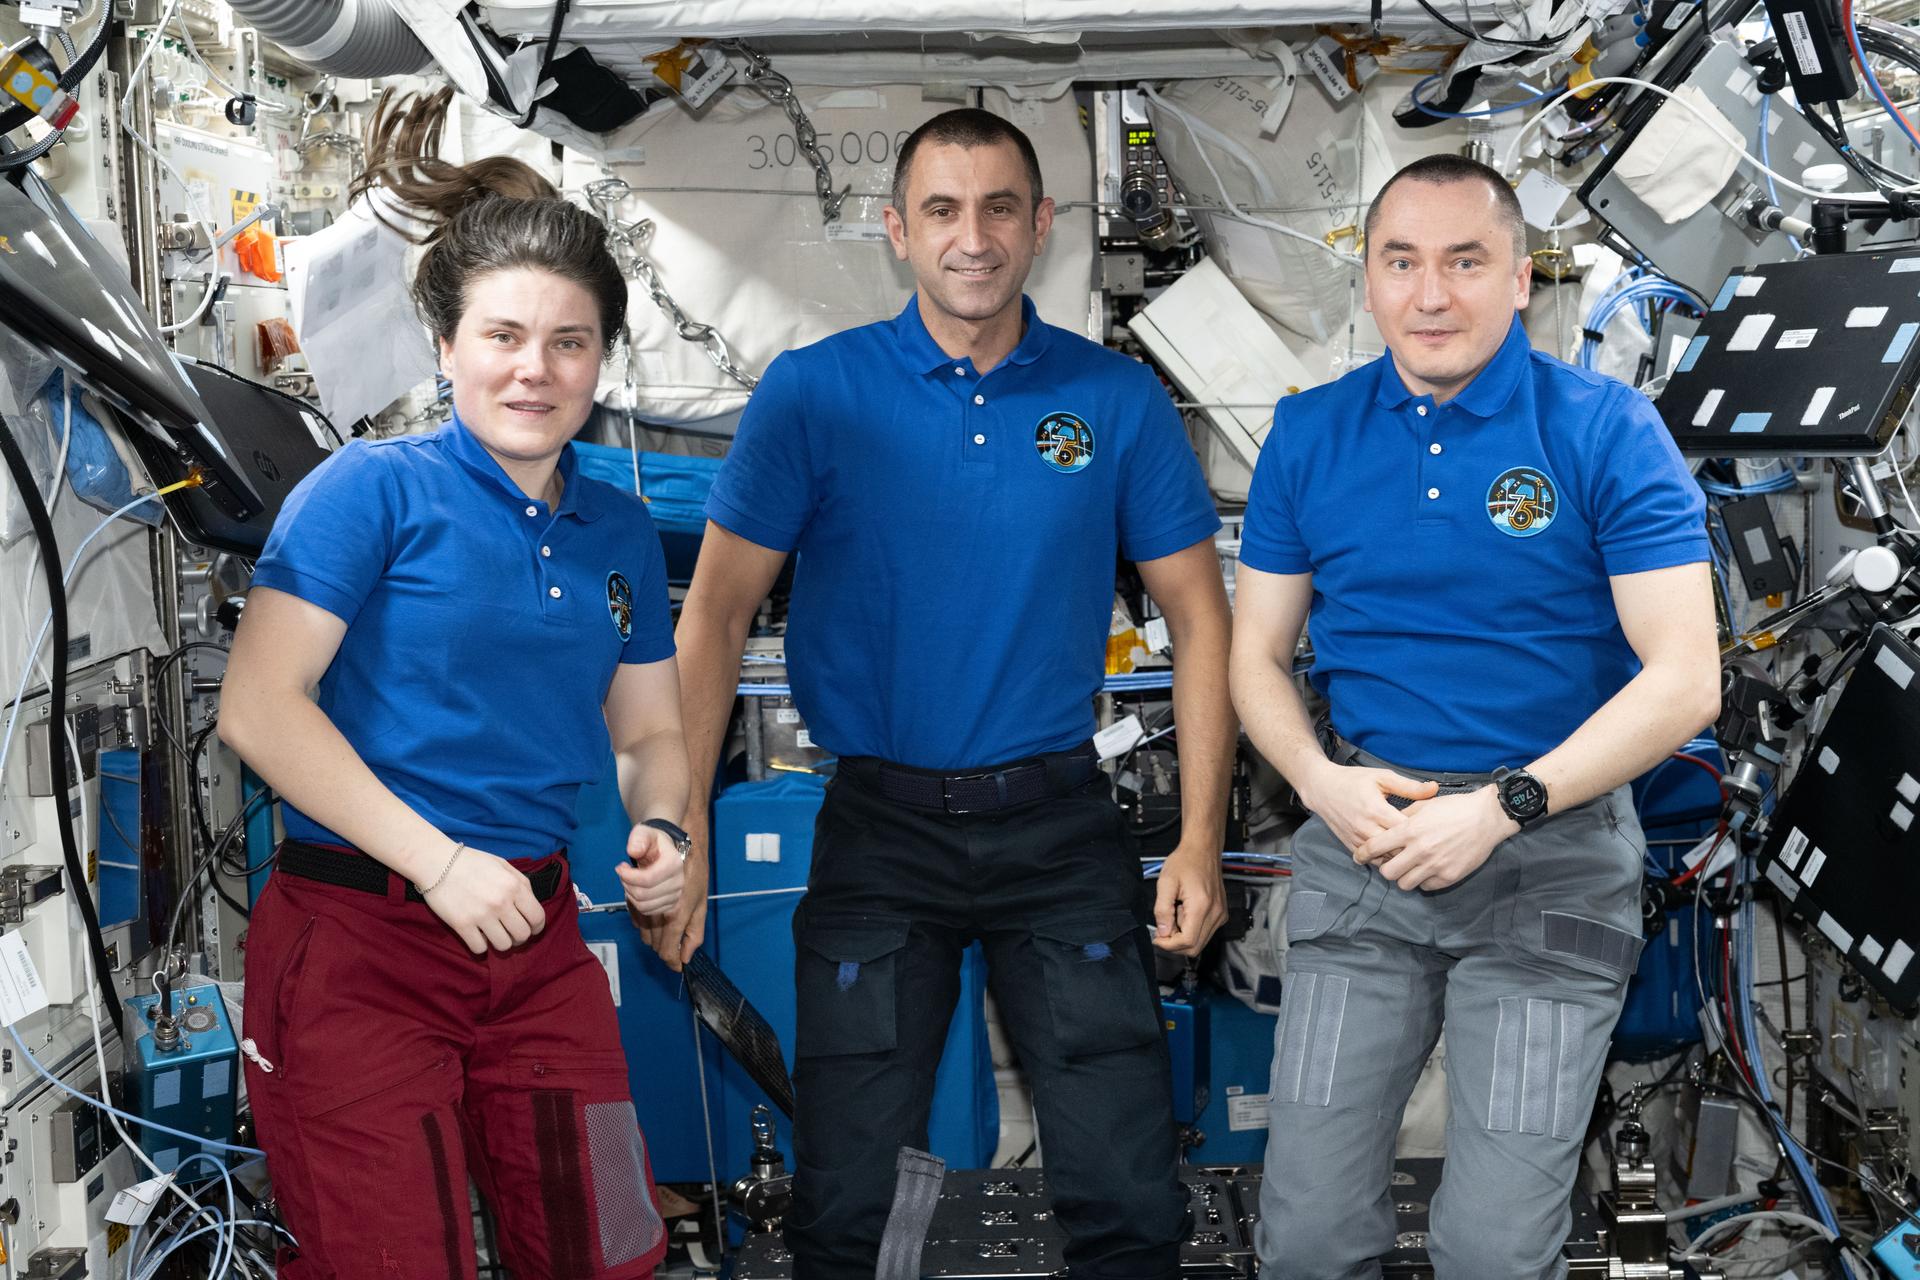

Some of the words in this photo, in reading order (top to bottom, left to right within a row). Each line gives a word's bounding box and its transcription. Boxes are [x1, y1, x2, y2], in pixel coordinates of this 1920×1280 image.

[1838, 403, 1861, 420] ThinkPad
[1051, 434, 1077, 467] 75
[1508, 493, 1537, 531] 75
[1512, 787, 1538, 806] 1748
